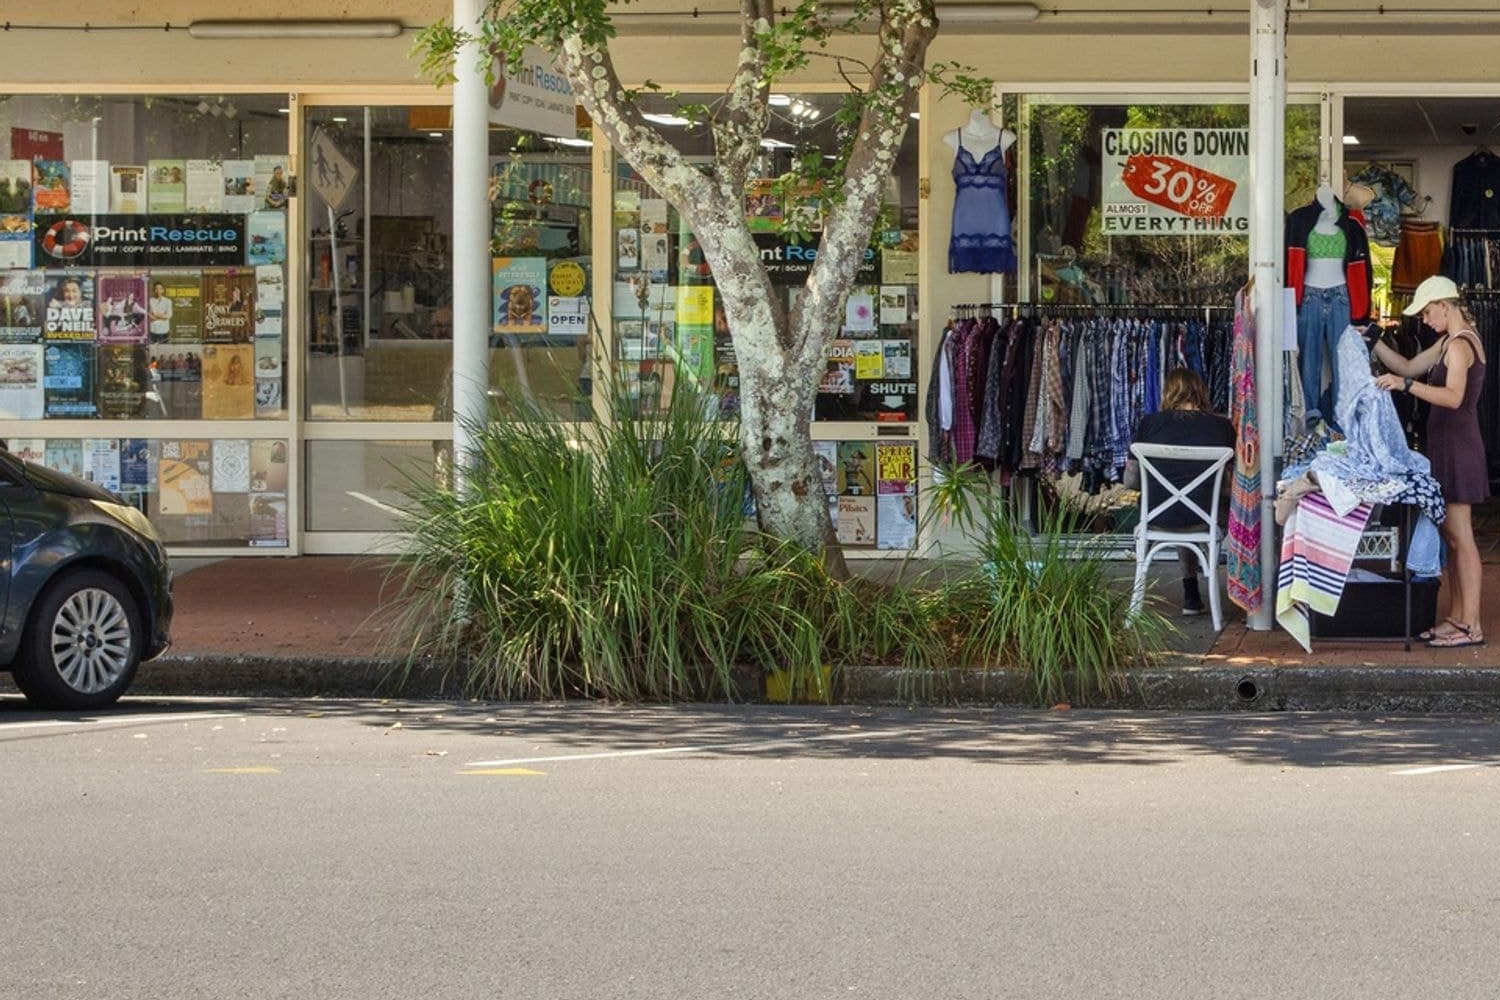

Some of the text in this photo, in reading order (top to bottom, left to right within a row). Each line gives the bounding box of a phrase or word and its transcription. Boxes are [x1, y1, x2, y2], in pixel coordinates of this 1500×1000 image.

[1105, 131, 1249, 156] CLOSING DOWN
[1144, 160, 1217, 204] 30%
[1106, 205, 1147, 214] ALMOST
[1189, 200, 1214, 214] OFF
[1105, 217, 1249, 230] EVERYTHING
[94, 226, 238, 241] Print Rescue
[46, 307, 94, 321] DAVE
[551, 315, 586, 325] OPEN
[46, 321, 95, 332] O'NEIL
[870, 382, 918, 395] SHUTE
[879, 463, 912, 479] FAIR
